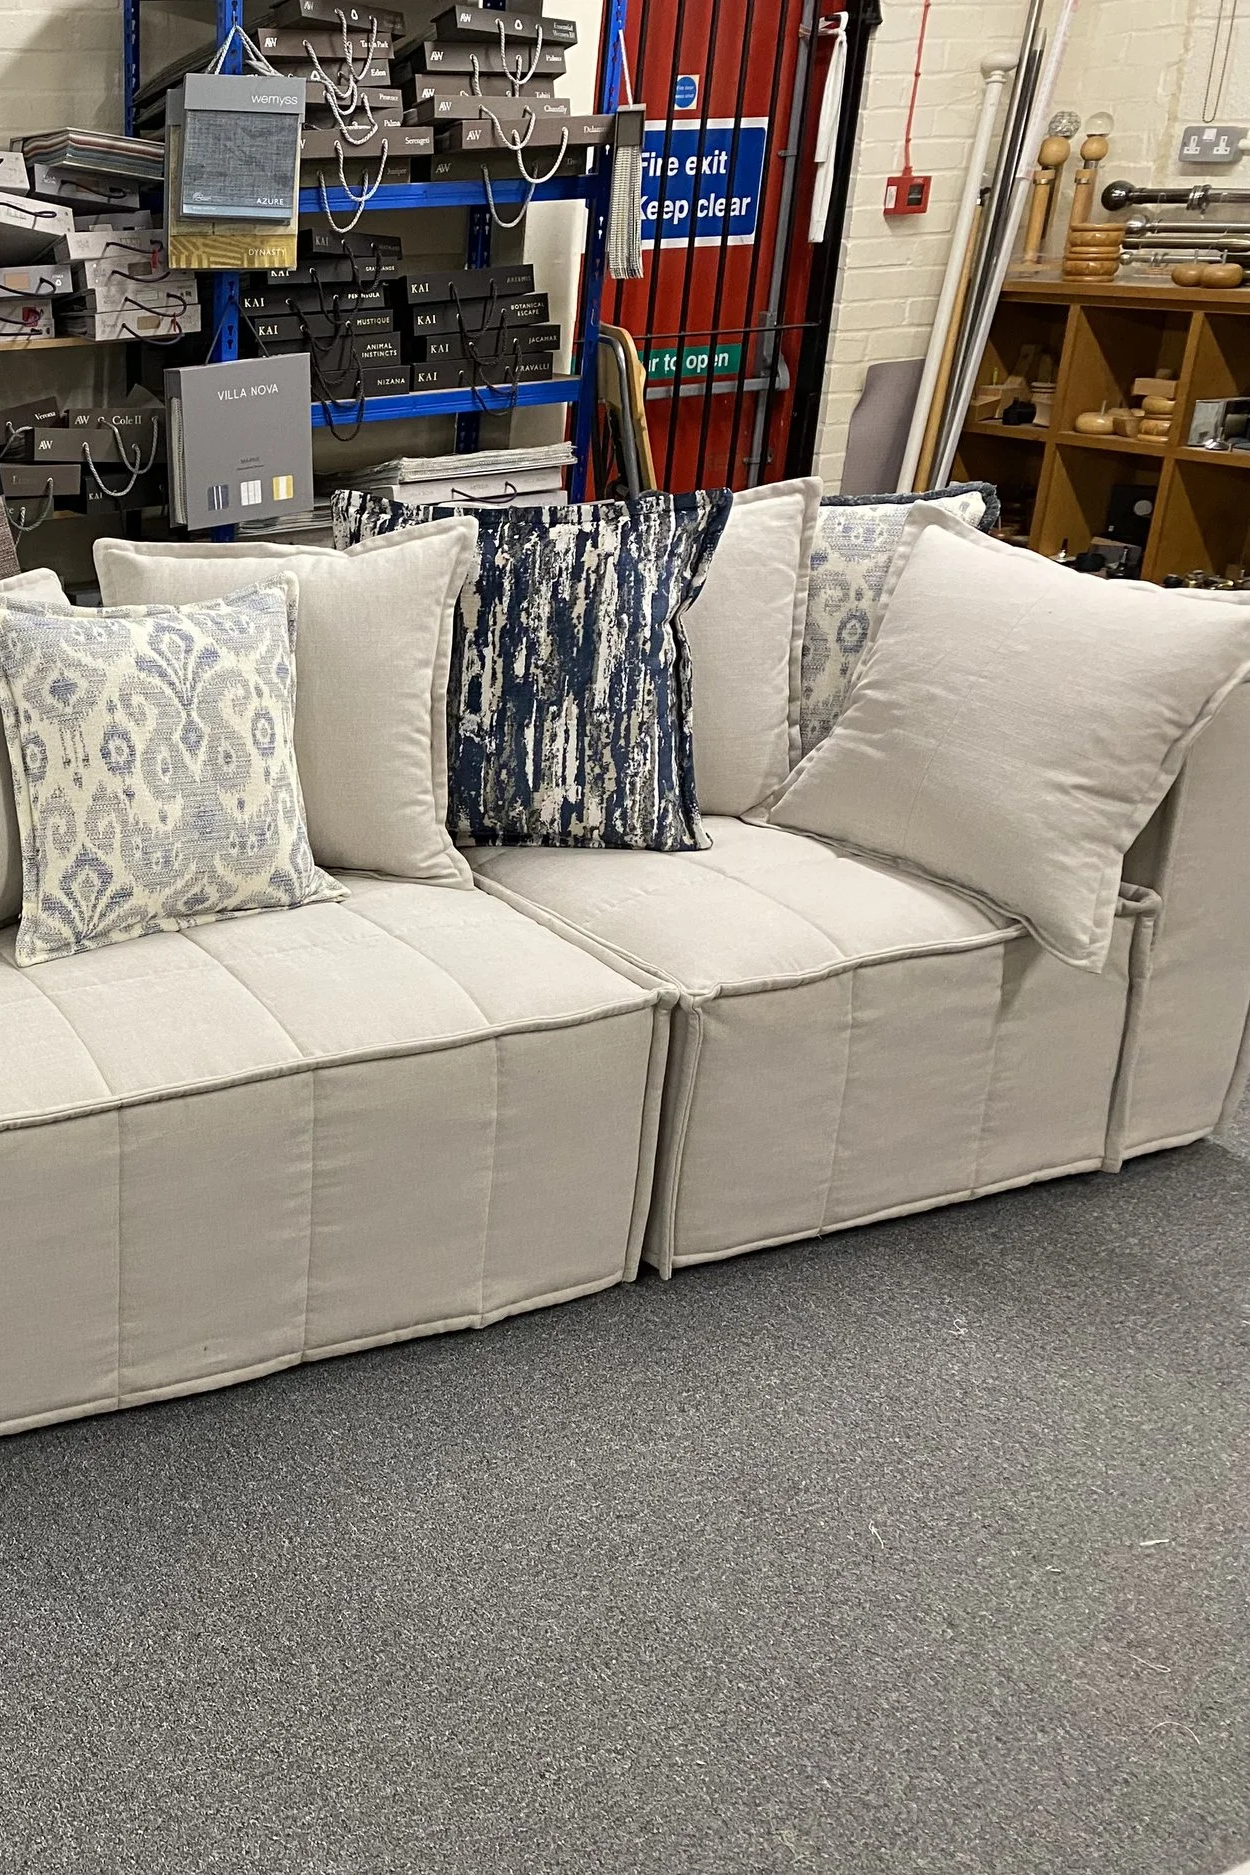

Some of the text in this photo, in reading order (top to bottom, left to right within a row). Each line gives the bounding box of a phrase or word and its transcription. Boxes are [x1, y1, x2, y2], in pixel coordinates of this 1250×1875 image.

[460, 13, 472, 23] AW
[264, 37, 277, 48] AW
[430, 51, 444, 61] AW
[370, 68, 386, 76] Eden
[251, 94, 298, 107] wemyss
[438, 102, 452, 111] AW
[467, 130, 482, 140] AW
[641, 150, 728, 177] Fire exit
[256, 197, 284, 206] AZURE
[640, 193, 751, 225] Keep clear
[315, 236, 329, 247] KAI
[248, 248, 287, 256] DYNASTY
[411, 283, 429, 294] KAI
[244, 297, 265, 308] KAI
[510, 302, 545, 311] BOTANICAL
[356, 316, 390, 326] MUSTIQUE
[417, 314, 436, 325] KAI
[258, 325, 278, 336] KAI
[366, 342, 393, 350] ANIMAL
[430, 343, 449, 354] KAI
[361, 350, 398, 359] INSTINCTS
[686, 352, 728, 373] open
[377, 377, 406, 386] NIZANA
[418, 371, 437, 382] KAI
[217, 383, 279, 401] VILLA NOVA
[34, 410, 56, 421] Verona
[74, 415, 90, 425] AW
[112, 415, 132, 425] Cole
[38, 440, 53, 450] AW
[88, 492, 103, 501] KAI
